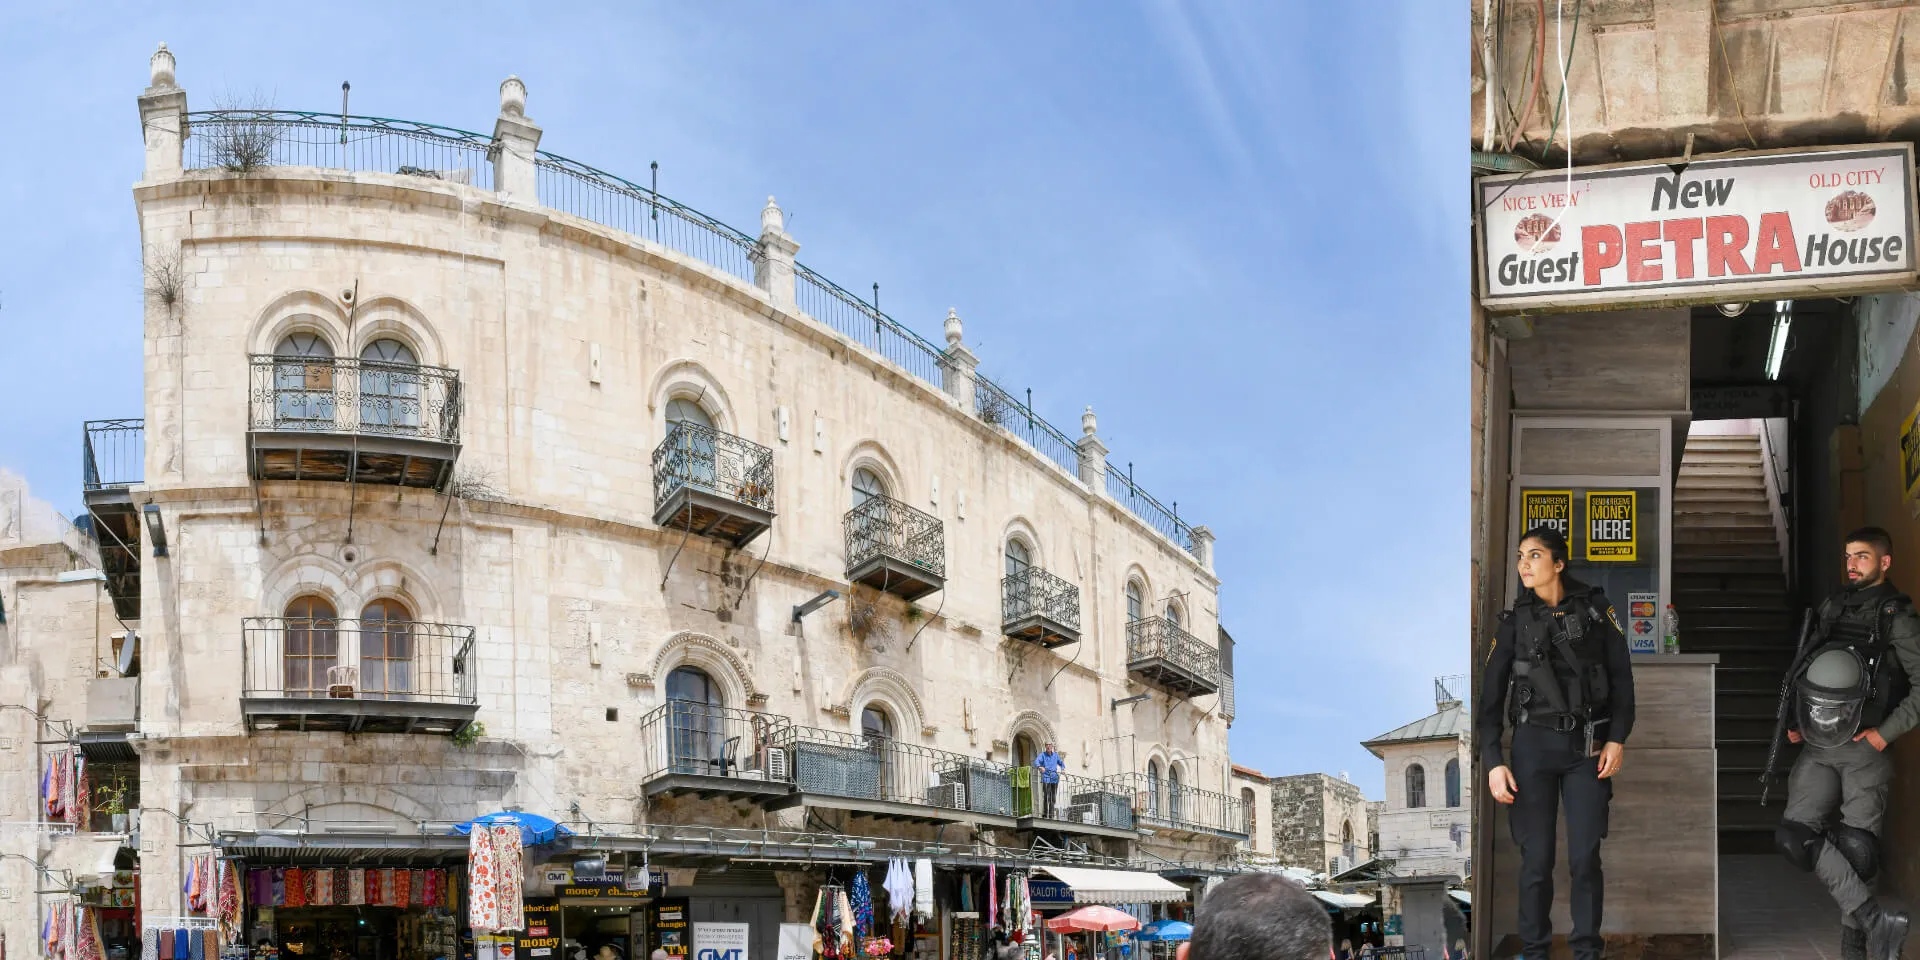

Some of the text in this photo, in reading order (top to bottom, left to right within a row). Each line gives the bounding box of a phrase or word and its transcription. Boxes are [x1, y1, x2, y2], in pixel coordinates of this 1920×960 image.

[1809, 167, 1886, 189] OLD CITY
[1503, 195, 1537, 212] NICE
[1541, 190, 1580, 209] VIEW
[1651, 176, 1735, 212] New
[1498, 211, 1903, 287] Guest PETRA House
[1529, 504, 1568, 519] MONEY
[1592, 505, 1631, 520] MONEY
[1592, 519, 1631, 540] HERE
[1634, 639, 1655, 648] VISA
[547, 873, 566, 881] GMT
[565, 887, 601, 897] money
[1030, 886, 1057, 897] KALOTI
[529, 917, 547, 926] best
[519, 937, 560, 949] money
